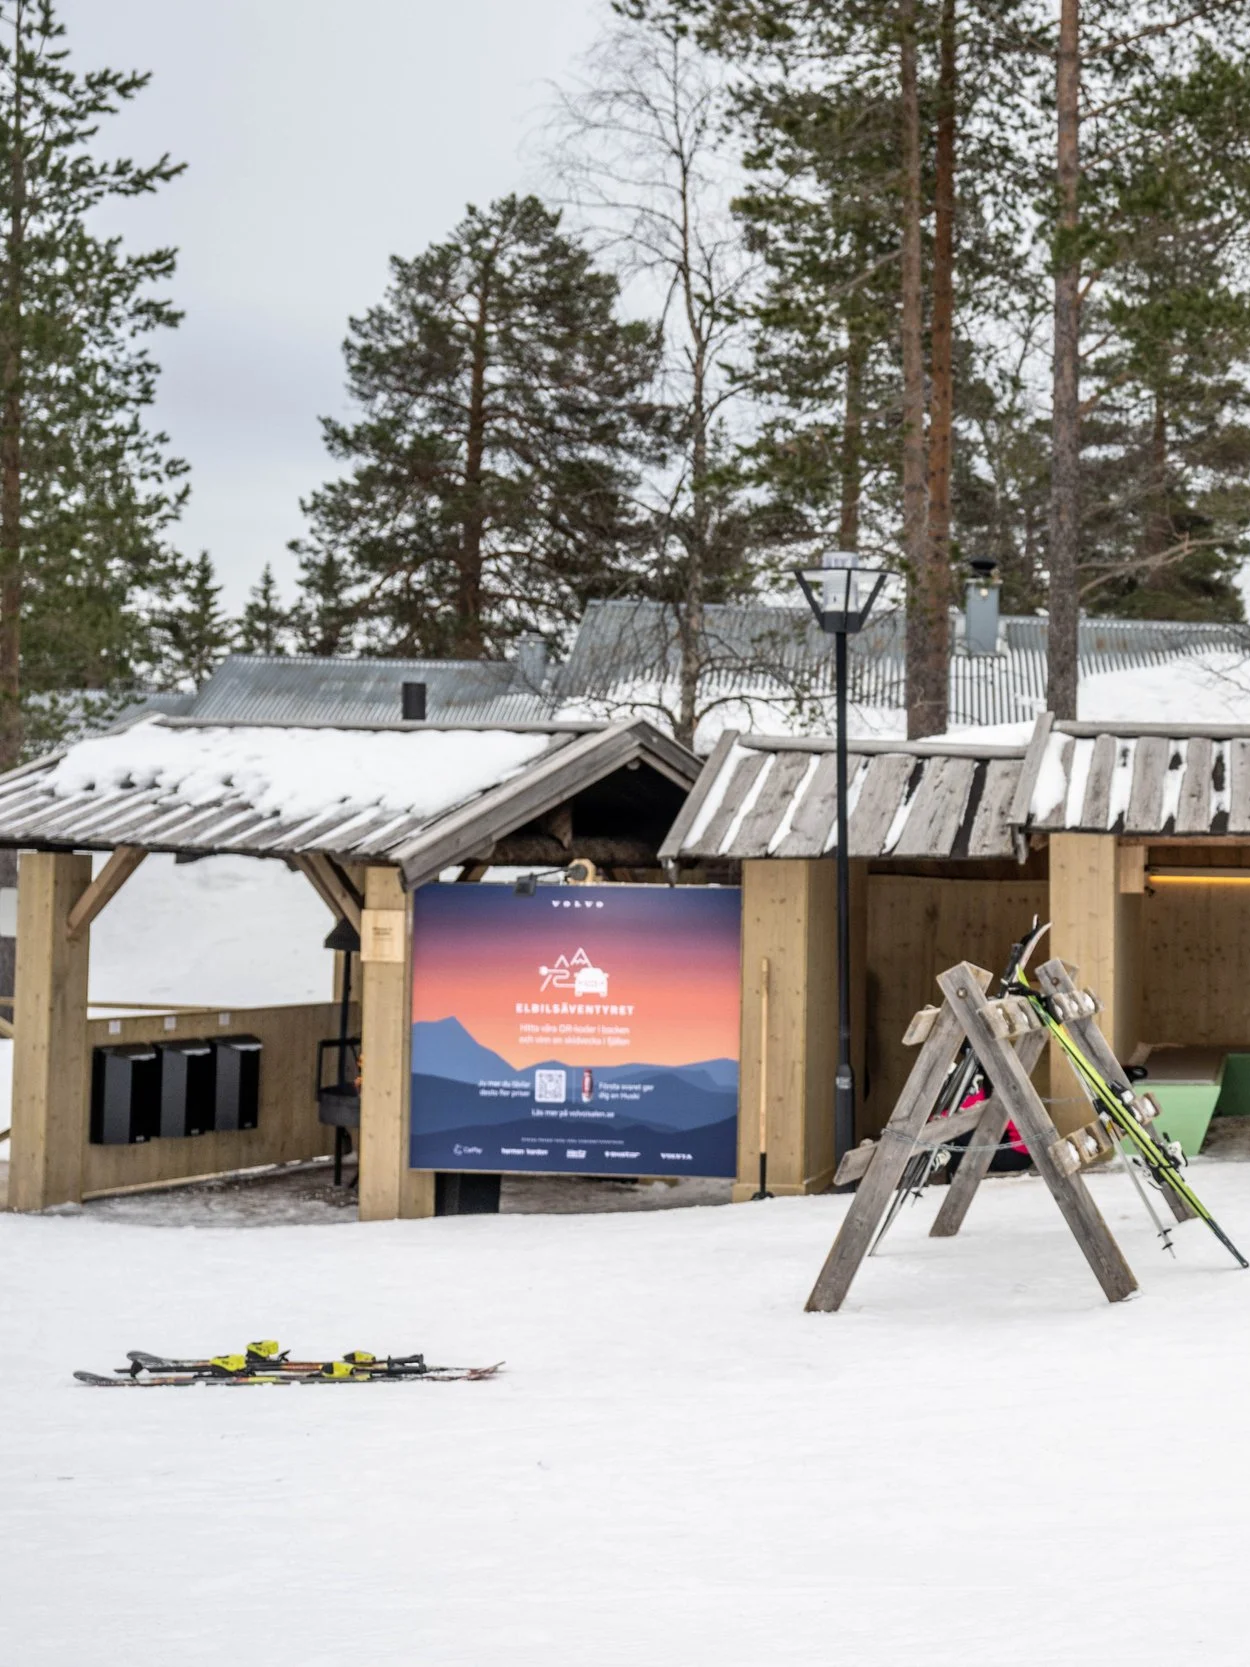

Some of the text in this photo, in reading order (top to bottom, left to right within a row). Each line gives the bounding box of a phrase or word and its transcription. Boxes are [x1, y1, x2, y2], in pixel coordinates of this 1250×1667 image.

[551, 900, 604, 909] VOLVO
[515, 1002, 635, 1016] ELBILSÄVENTYRET
[519, 1024, 540, 1033] Hitta
[559, 1024, 597, 1033] QR-koder
[601, 1025, 630, 1034] backen
[519, 1036, 534, 1044] och
[535, 1036, 552, 1044] vinn
[564, 1036, 602, 1045] skidvecka
[606, 1037, 631, 1047] fjällen
[479, 1088, 498, 1097] desto
[531, 1108, 544, 1117] Läs
[545, 1109, 558, 1117] mer
[559, 1109, 568, 1119] på
